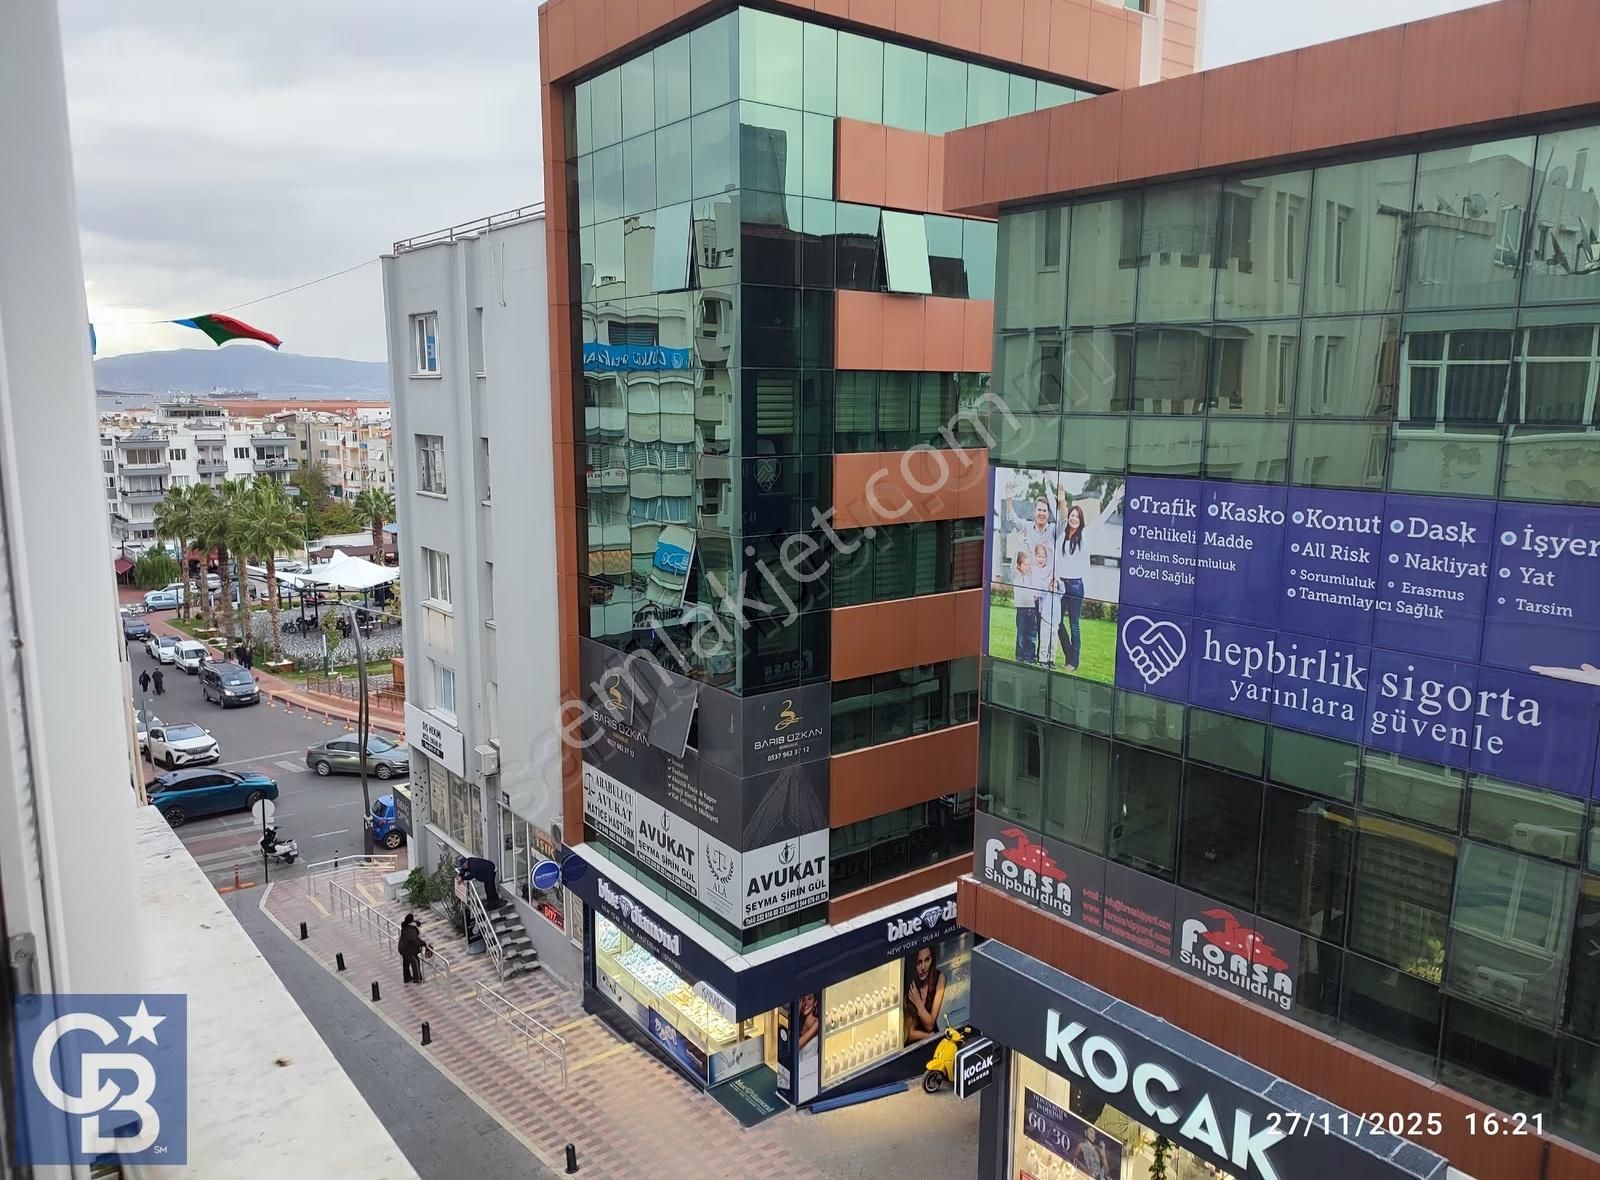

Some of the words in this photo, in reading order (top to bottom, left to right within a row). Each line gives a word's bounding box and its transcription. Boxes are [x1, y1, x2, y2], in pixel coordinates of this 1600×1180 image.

[1139, 495, 1197, 518] Trafik
[1220, 502, 1285, 525] Kasko
[1305, 508, 1381, 535] Konut
[1408, 517, 1477, 544] Dask
[1138, 525, 1197, 544] Tehlikeli
[1203, 531, 1253, 550] Madde
[1137, 550, 1170, 564] Hekim
[1172, 554, 1237, 571] Sorumluluk
[1301, 542, 1326, 559] All
[1330, 544, 1371, 564] Risk
[1404, 552, 1488, 578] Nakliyat
[1136, 564, 1159, 580] Özel
[1161, 570, 1195, 586] Sağlık
[1299, 570, 1376, 590] Sorumluluk
[1519, 567, 1556, 587] Yat
[1299, 587, 1392, 612] Tamamlayıcı
[1396, 600, 1444, 619] Sağlık
[1401, 582, 1465, 601] Erasmus
[1515, 598, 1573, 617] Tarsim
[1202, 629, 1367, 692] hepbirlik
[1381, 665, 1542, 727] sigorta
[1229, 679, 1356, 722] yarınlara
[1370, 709, 1504, 755] güvenle
[767, 752, 781, 762] 0537
[596, 774, 633, 807] ARABULUCU
[598, 792, 633, 823] AVUKAT
[639, 819, 695, 867] AVUKAT
[638, 839, 660, 860] ŞEYMA
[681, 867, 696, 883] GÜL
[746, 856, 826, 897] AVUKAT
[745, 896, 778, 915] ŞEYMA
[780, 886, 806, 902] ŞİRİN
[808, 879, 826, 892] GÜL
[984, 868, 1072, 917] Shipbuilding
[598, 878, 620, 910] blue
[631, 904, 680, 957] diamond
[887, 917, 923, 943] blue
[887, 946, 902, 957] NEW
[903, 940, 918, 950] YORK
[922, 931, 940, 943] DUBAI
[1179, 950, 1291, 1011] Shipbuilding
[967, 1070, 990, 1086] DIAMOND
[1045, 1007, 1288, 1180] KOÇAK
